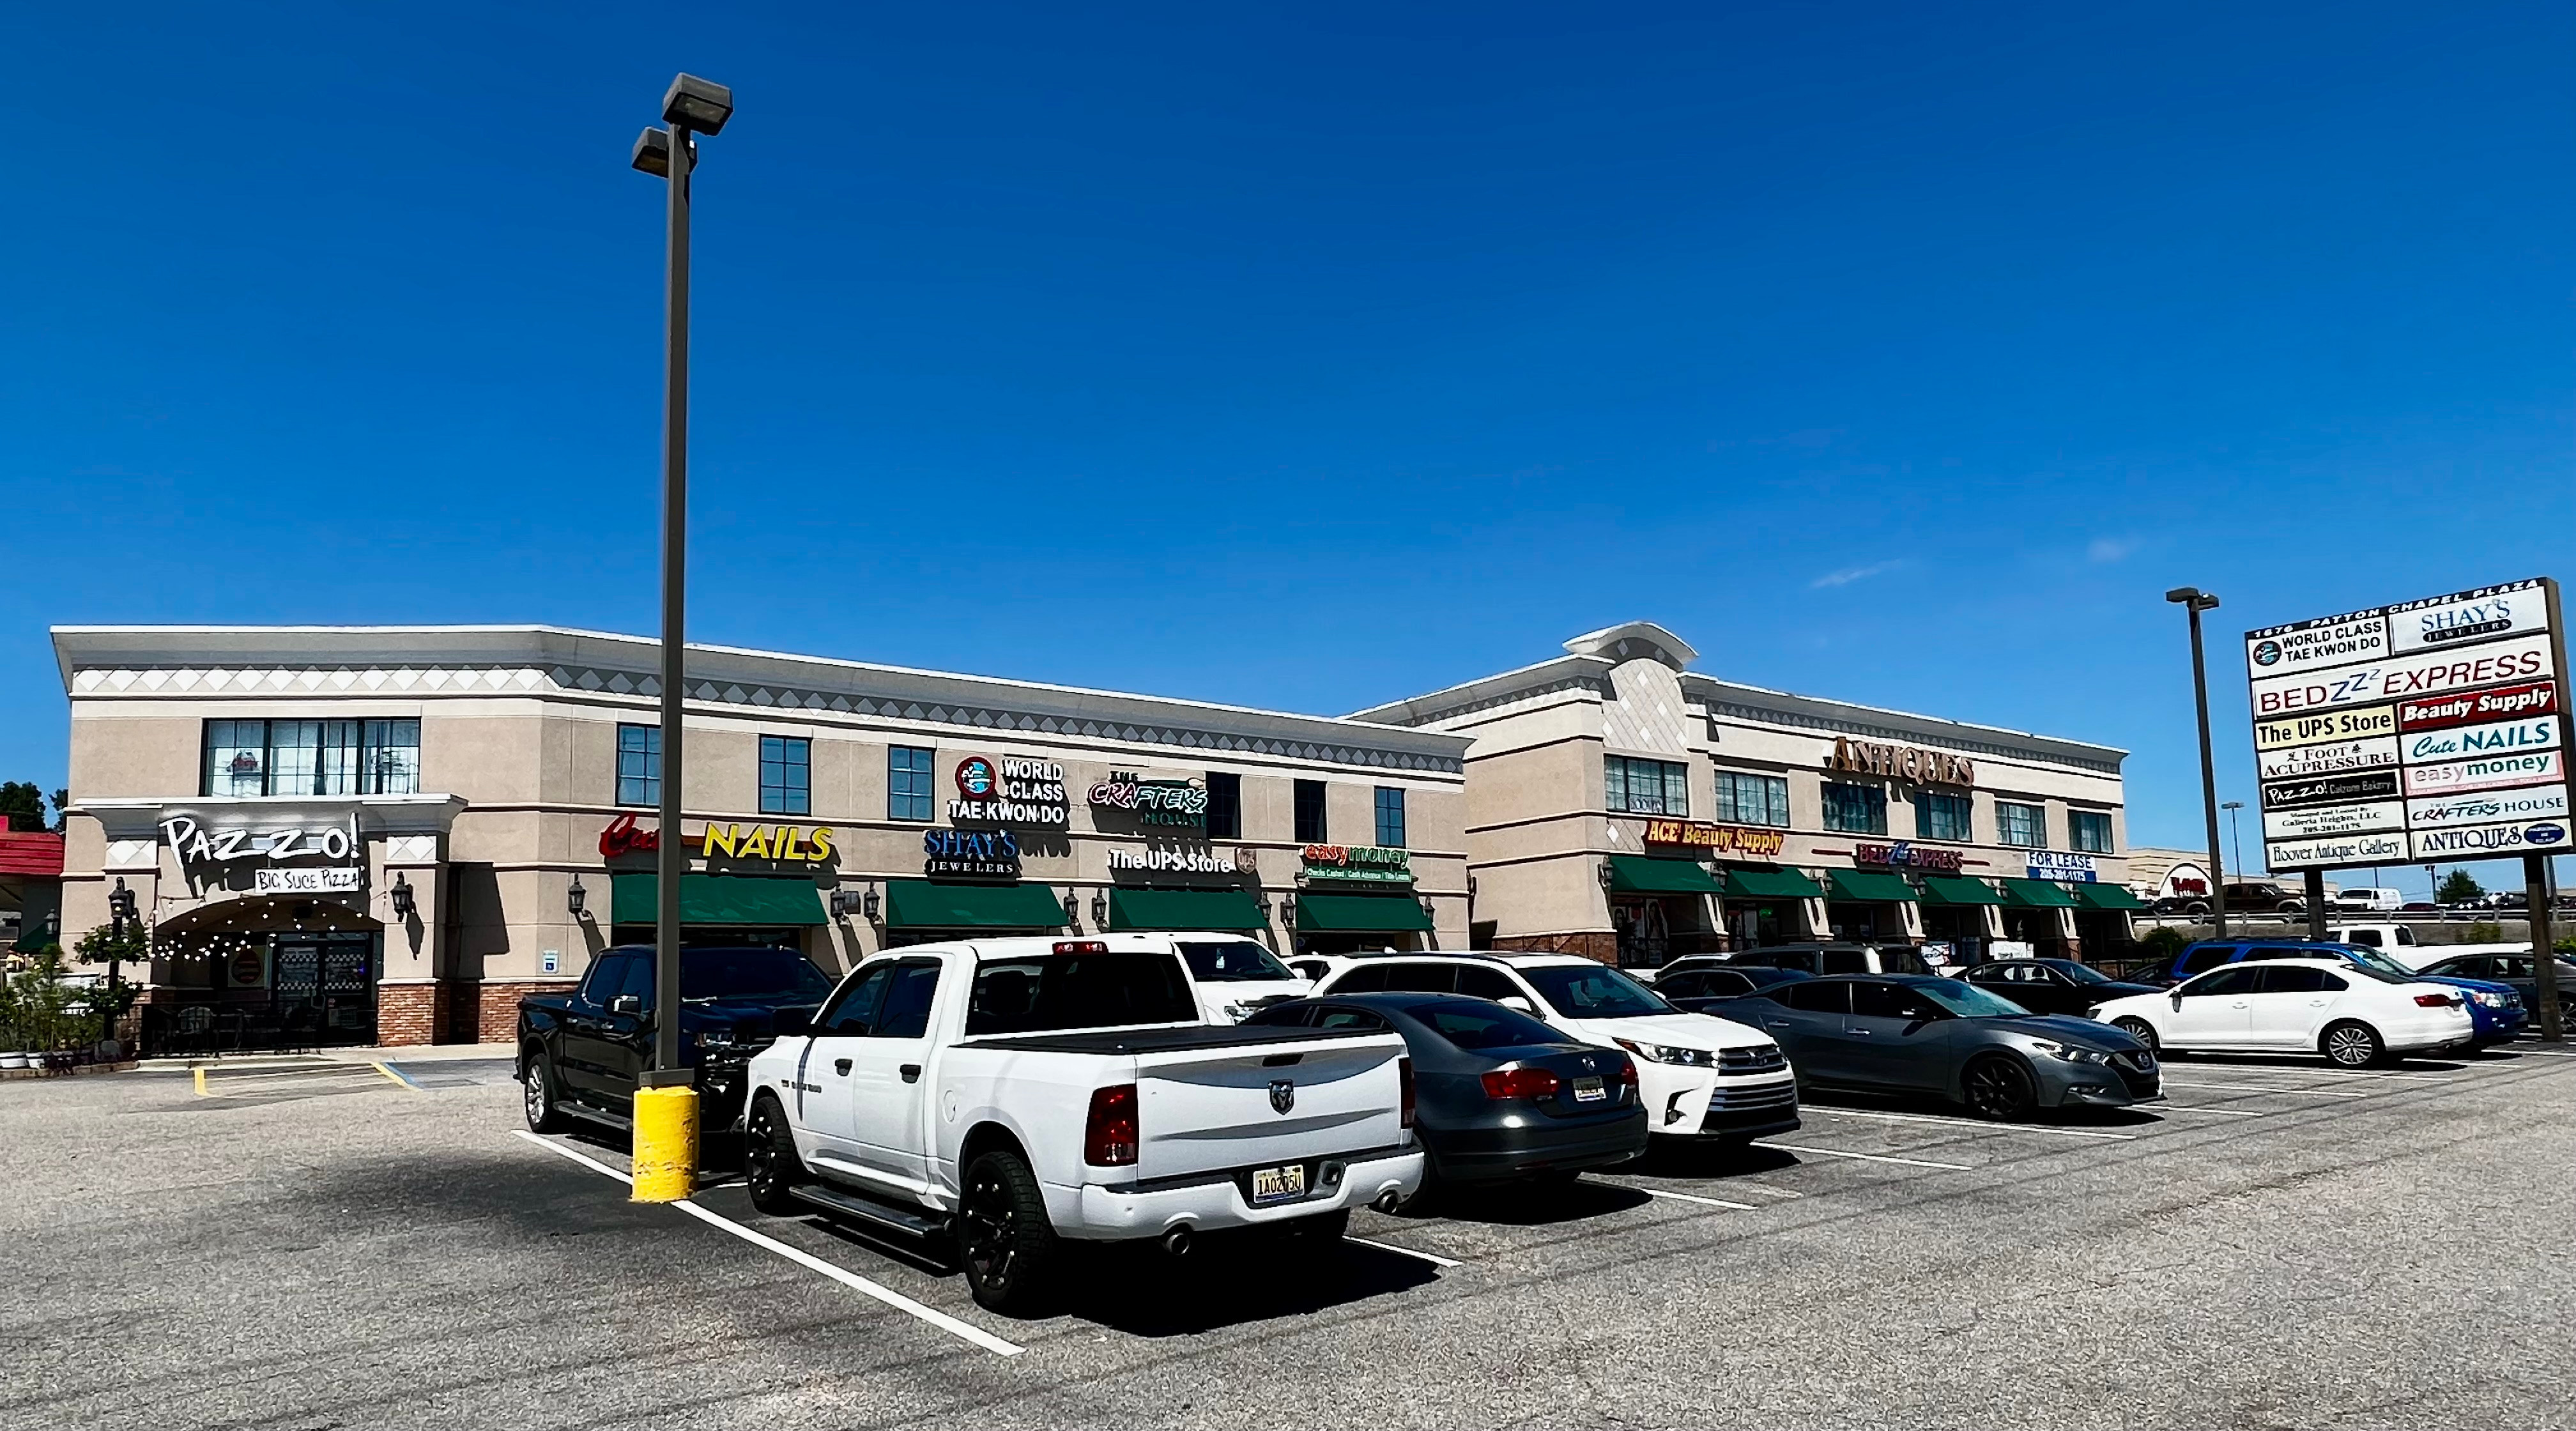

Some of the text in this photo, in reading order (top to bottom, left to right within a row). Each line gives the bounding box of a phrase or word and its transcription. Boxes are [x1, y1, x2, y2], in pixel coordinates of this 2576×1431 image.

[2310, 608, 2380, 628] PATTON
[2388, 594, 2464, 613] CHAPEL
[2472, 579, 2538, 598] PLAZA
[2421, 599, 2510, 632] SHAY'S
[2281, 621, 2382, 649] WORLD CLASS
[2427, 621, 2509, 641] JEWELERS
[2285, 636, 2380, 662] TAE KWON DO
[2383, 650, 2541, 695] EXPRESS
[2403, 688, 2552, 722] Beauty Supply
[2258, 714, 2392, 744] The UPS Store
[2412, 723, 2550, 758] Cute NAILS
[1003, 760, 1064, 781] WORLD
[1110, 770, 1138, 783] THE
[2414, 755, 2549, 783] easymoney
[1009, 781, 1063, 802] CLASS
[1089, 782, 1208, 814] CRAFTERS
[949, 800, 1064, 824] TAE KWON DO
[2412, 797, 2564, 821] CRAFTERS HOUSE
[702, 822, 834, 861] NAILS
[925, 830, 1017, 857] SHAY'S
[1682, 824, 1733, 850] Beauty
[1735, 829, 1782, 853] Supply
[2273, 839, 2400, 862] Hoover Antique Gallery
[2421, 826, 2522, 852] ANTIQUES
[930, 861, 1014, 873] JEWELERS
[1109, 849, 1230, 873] The UPS Store
[1305, 844, 1411, 870] easymoney
[1910, 848, 1964, 869] EXPRESS
[2029, 850, 2092, 869] FOR LEASE
[257, 871, 280, 890] BIG
[321, 869, 359, 888] PIZZA
